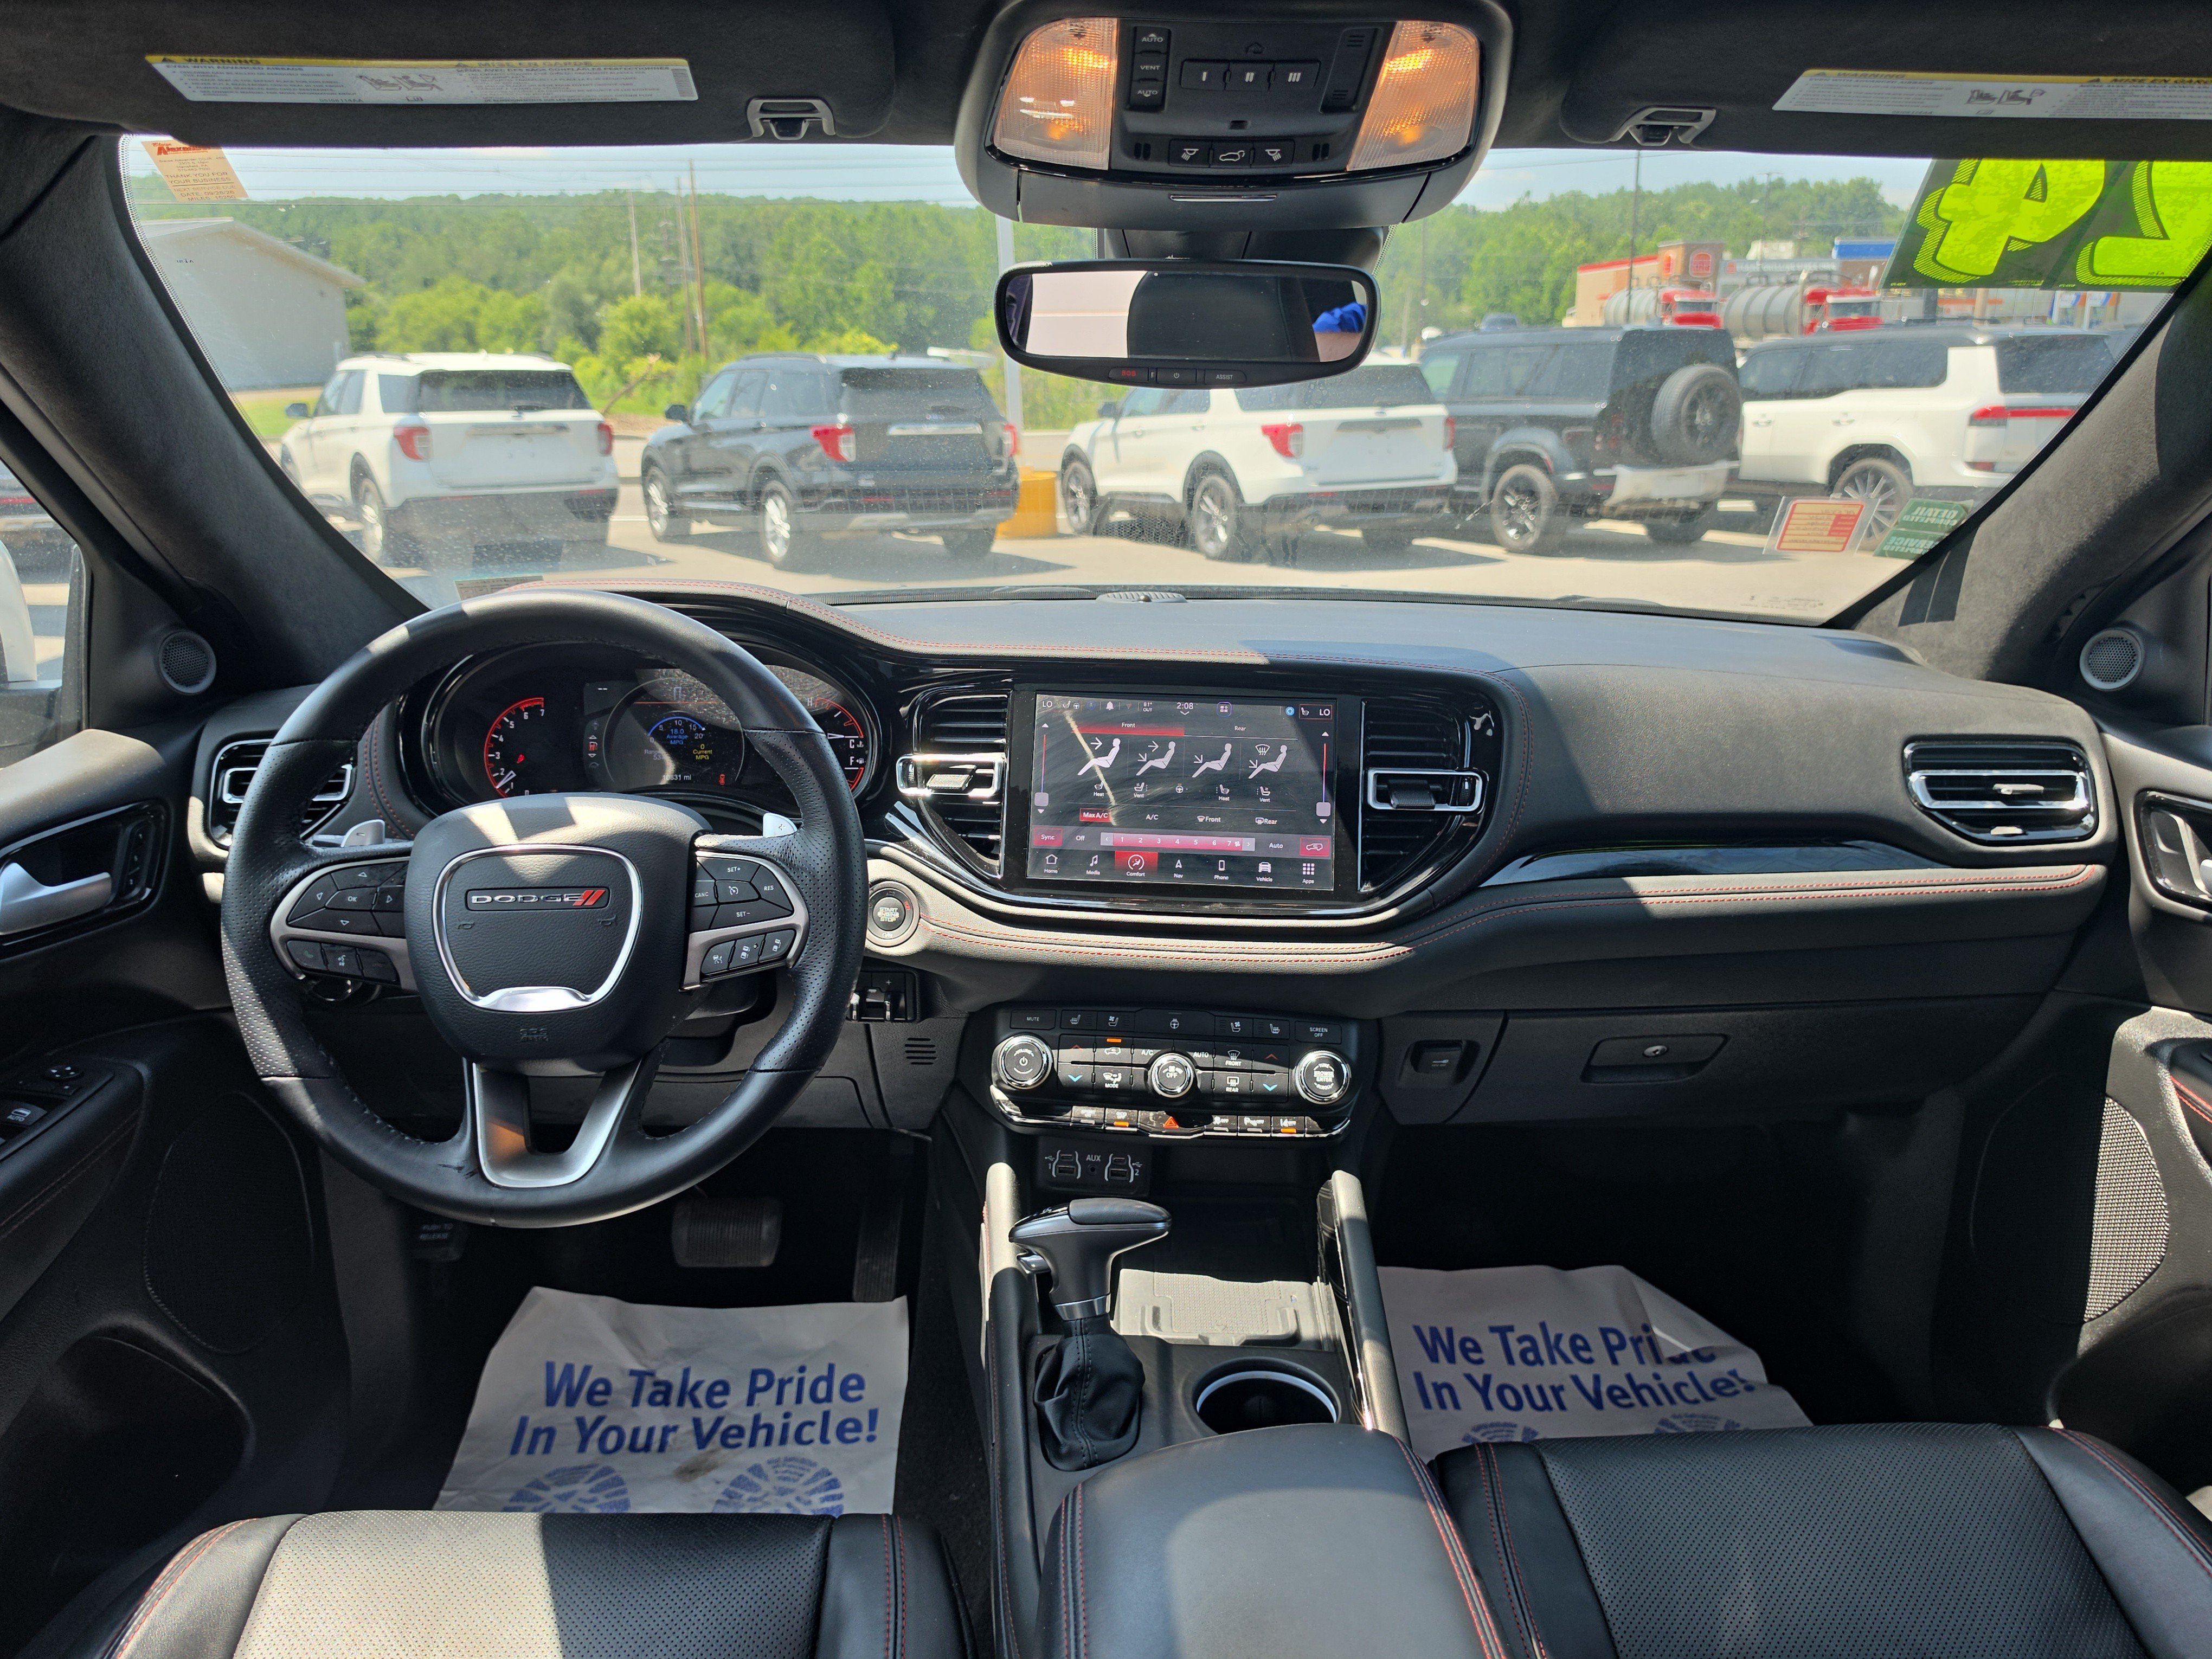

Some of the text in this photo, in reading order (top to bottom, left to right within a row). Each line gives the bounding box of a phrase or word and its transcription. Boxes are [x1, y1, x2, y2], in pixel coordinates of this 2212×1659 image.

[807, 697, 813, 706] H
[498, 735, 504, 743] 4
[850, 739, 854, 748] C
[850, 756, 854, 766] F
[471, 892, 584, 904] DODGE
[1412, 1324, 1484, 1365] We
[1489, 1321, 1595, 1367] Take
[545, 1361, 866, 1409] We Take Pride
[1413, 1367, 1756, 1412] In Your Vehicle!
[510, 1409, 879, 1456] In Your Vehicle!
